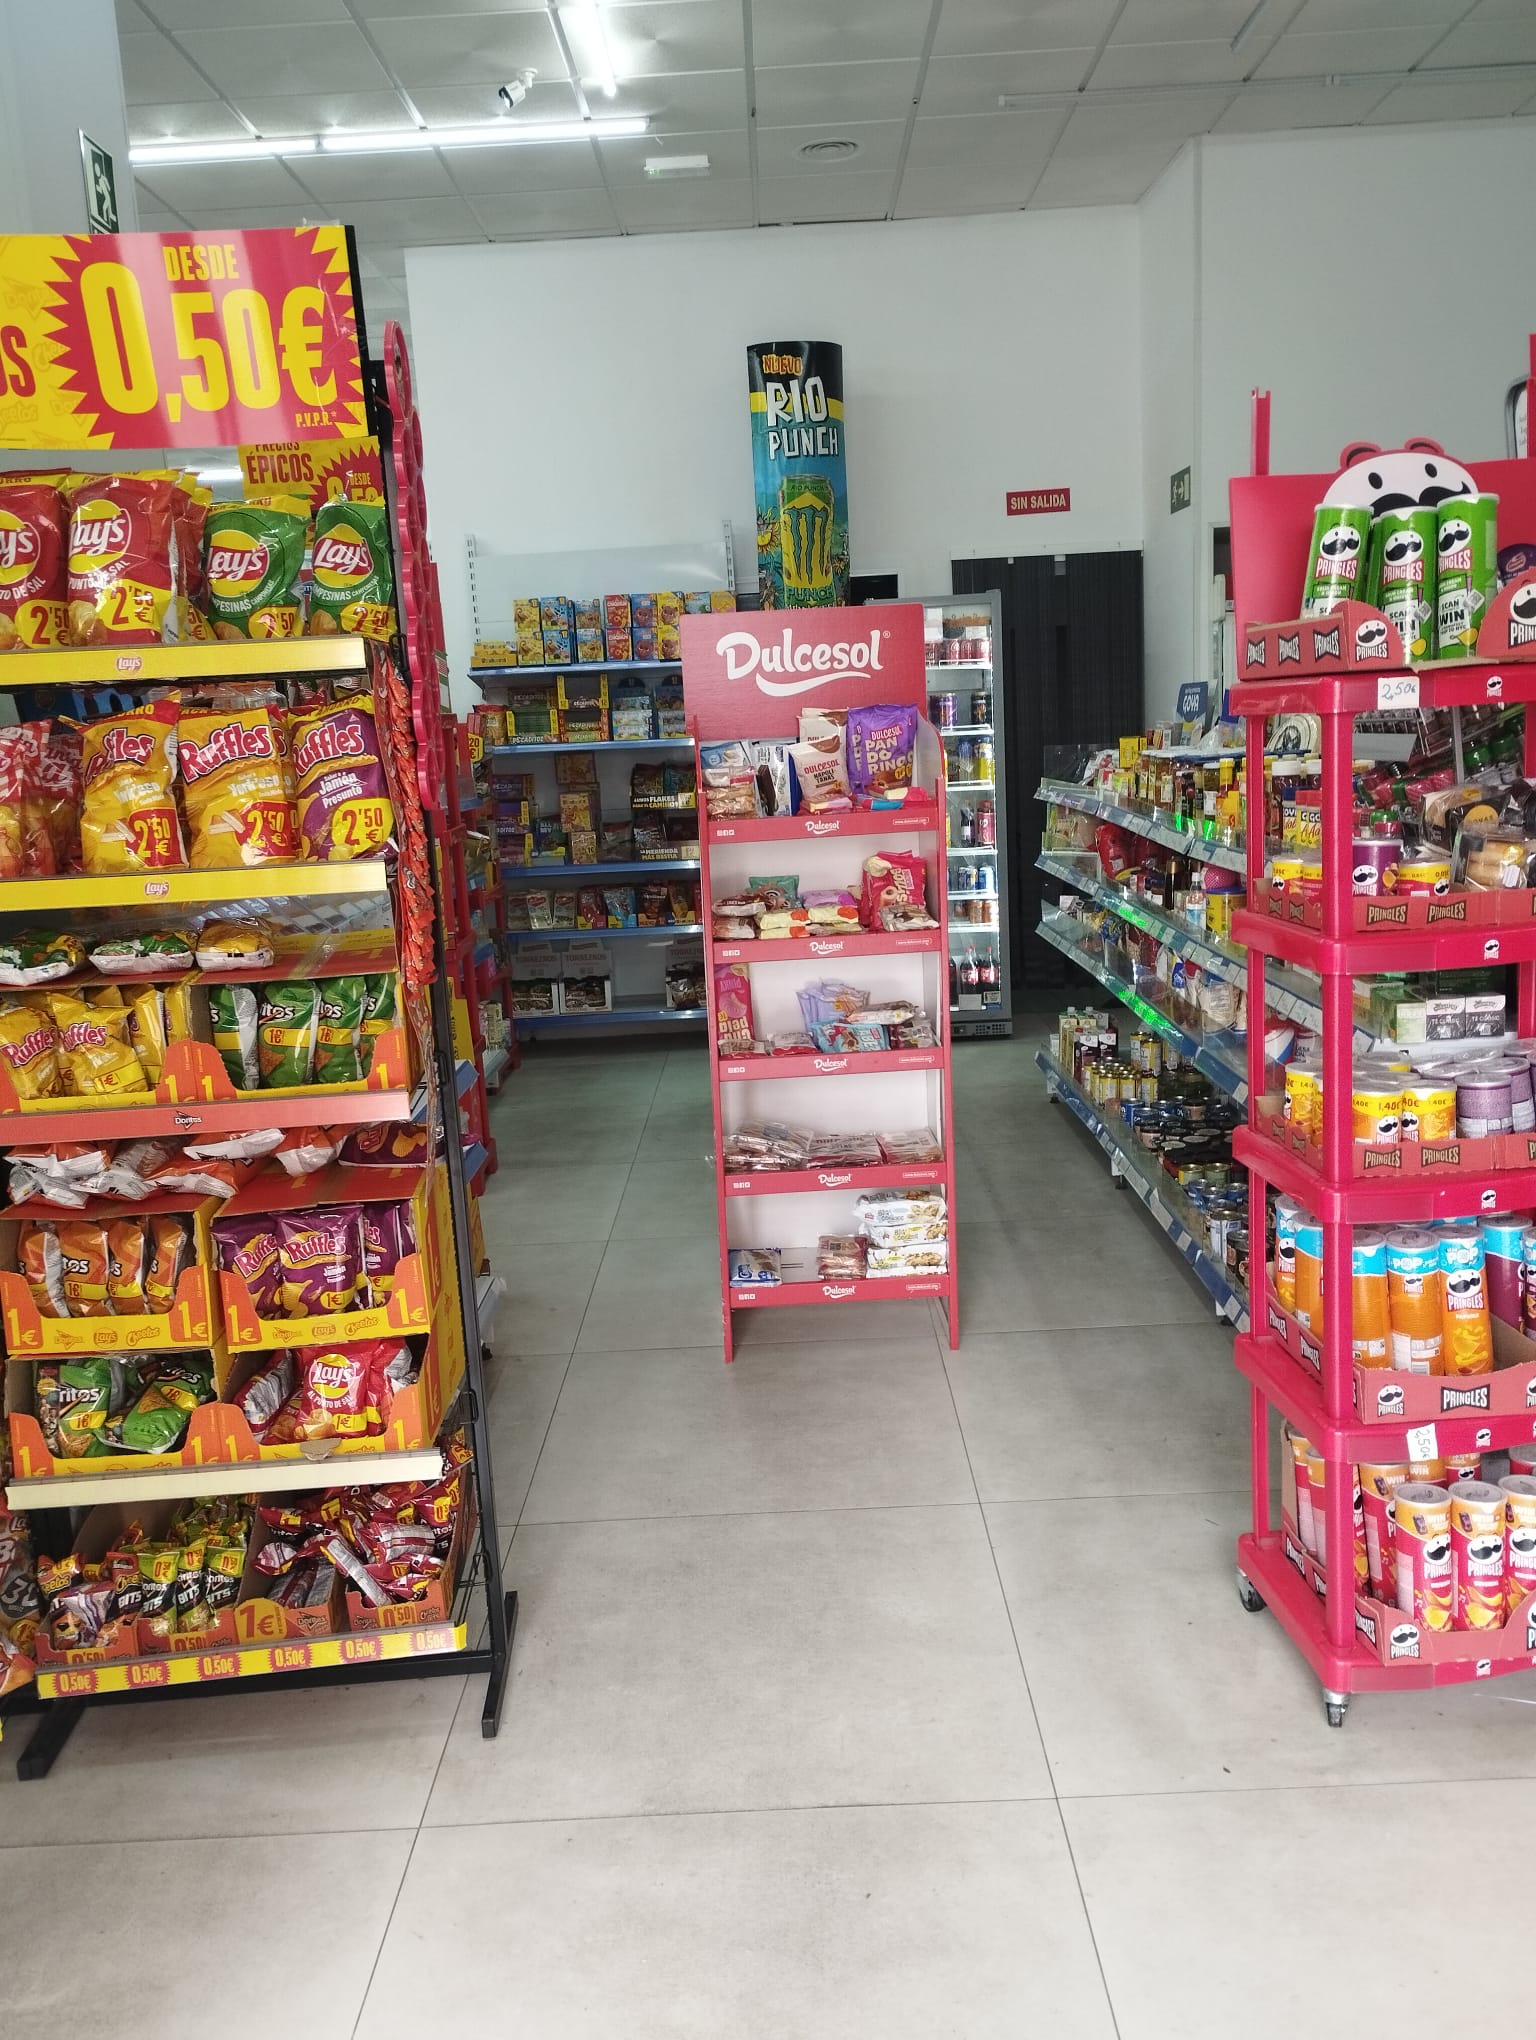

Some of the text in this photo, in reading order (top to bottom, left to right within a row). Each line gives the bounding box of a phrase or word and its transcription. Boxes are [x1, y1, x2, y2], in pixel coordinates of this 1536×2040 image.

[162, 244, 239, 281] DESDE
[80, 261, 338, 423] 0,50€
[764, 355, 802, 375] NUEVO
[766, 376, 829, 427] RIO
[769, 427, 839, 459] PUNCH
[246, 450, 314, 484] ÉPICOS
[350, 472, 371, 485] DESDE
[1010, 493, 1067, 510] SIN SALIDA
[314, 535, 369, 575] Lay's
[109, 560, 131, 575] SAL
[1316, 557, 1356, 579] PRINGLES
[1384, 561, 1422, 583] PRINGLES
[26, 576, 47, 595] SAL
[1441, 599, 1459, 611] SCAN
[1439, 609, 1465, 625] WIN
[1314, 629, 1340, 658] PRINGLES
[1356, 644, 1388, 659] PRINGLES
[178, 721, 274, 785] Ruffles
[865, 737, 898, 751] PAN
[867, 751, 892, 763] DO
[319, 772, 357, 795] Jamón
[322, 786, 363, 809] Presunto
[805, 820, 840, 832] Dulcesol
[1368, 905, 1406, 922] PRINGLES
[1428, 902, 1465, 921] PRINGLES
[810, 941, 844, 952] Dulcesol
[2, 1025, 57, 1067] Ruffles
[59, 1022, 107, 1052] uffles
[814, 1059, 848, 1070] Dulcesol
[1366, 1151, 1400, 1168] PRINGLES
[1422, 1147, 1460, 1165] PRINGLES
[818, 1174, 852, 1185] Dulcesol
[284, 1233, 346, 1263] Ruffles
[1446, 1248, 1479, 1264] POP
[1393, 1257, 1423, 1269] POP
[823, 1286, 856, 1297] Dulcesol
[395, 1289, 425, 1325] 1€
[1448, 1292, 1484, 1311] PRINGLES
[7, 1308, 38, 1346] 1€
[179, 1301, 208, 1339] 1€
[228, 1305, 256, 1343] 1€
[345, 1316, 378, 1336] Cheetos
[126, 1327, 160, 1346] Cheetos
[315, 1363, 353, 1390] Lay's
[1377, 1402, 1404, 1416] PRINGLES
[1443, 1388, 1488, 1411] PRINGLES
[1386, 1474, 1406, 1486] WIN
[1468, 1559, 1503, 1577] PRINGLES
[118, 1591, 142, 1607] BITS
[178, 1585, 200, 1604] BITS
[239, 1604, 275, 1639] 1€
[274, 1648, 306, 1667] 0,50€
[345, 1640, 378, 1660] 0,50€
[1390, 1645, 1420, 1659] PRINGLES
[132, 1666, 164, 1685] 0,50€
[203, 1657, 234, 1676] 0,50€
